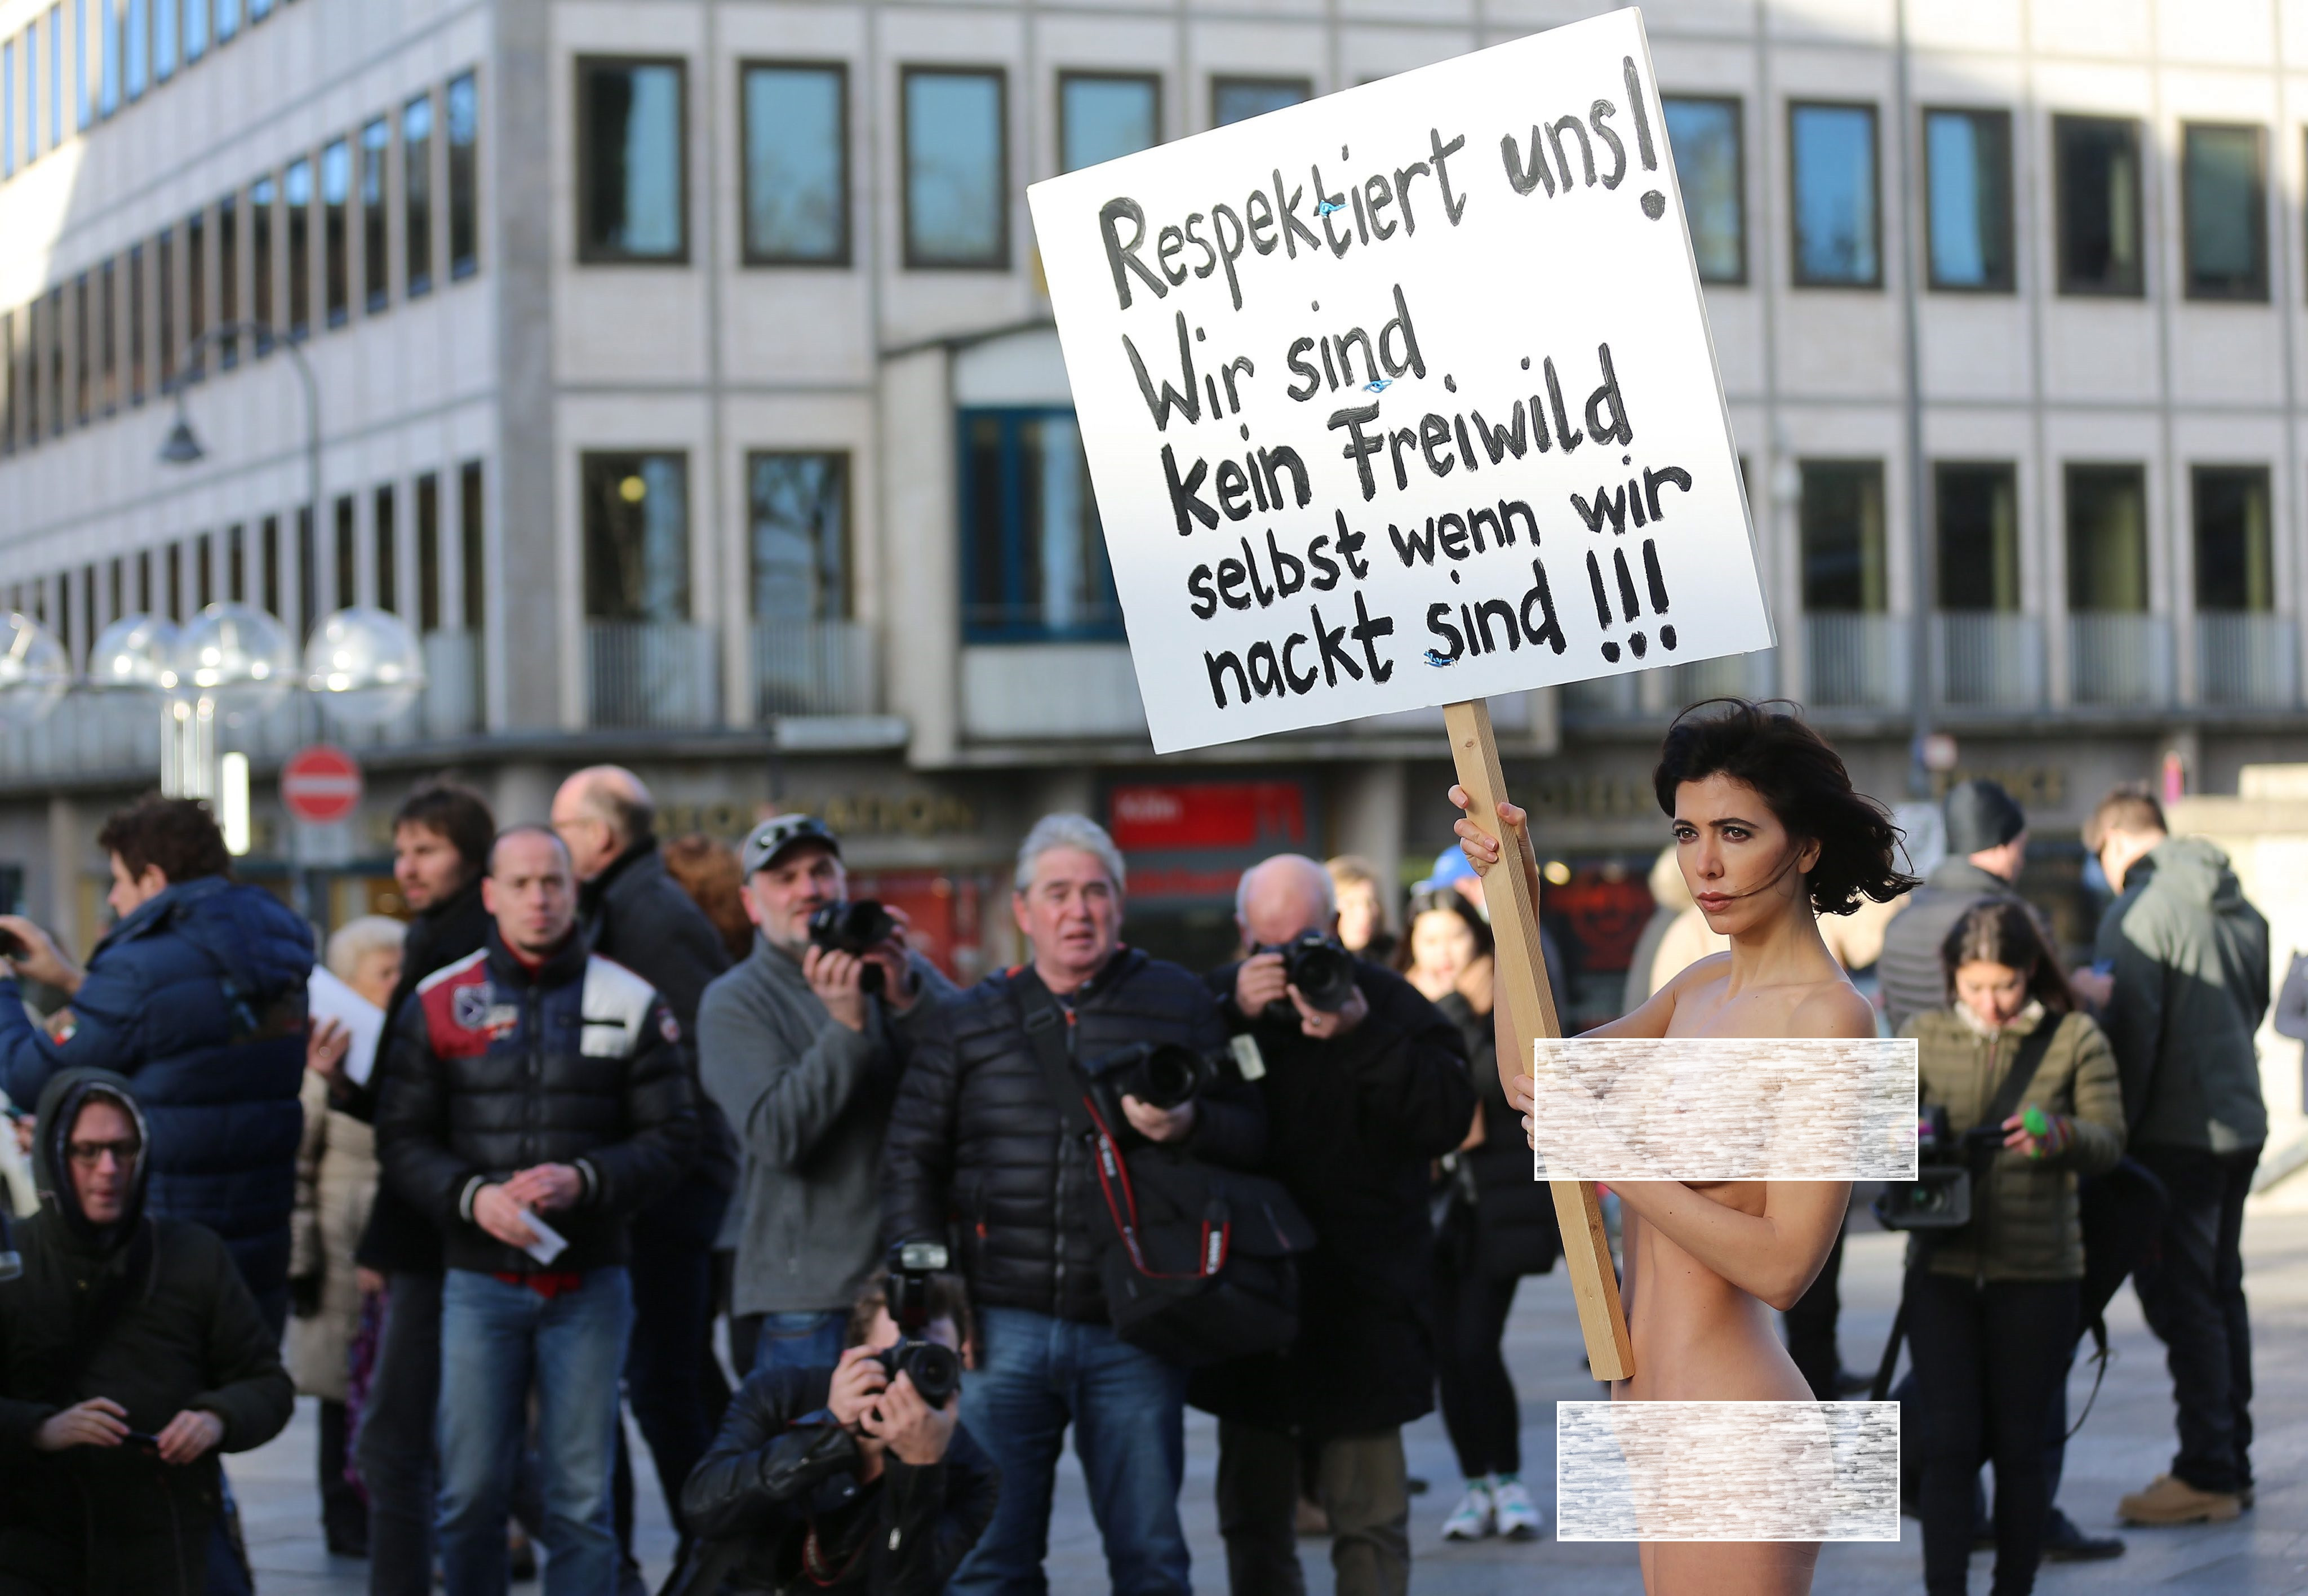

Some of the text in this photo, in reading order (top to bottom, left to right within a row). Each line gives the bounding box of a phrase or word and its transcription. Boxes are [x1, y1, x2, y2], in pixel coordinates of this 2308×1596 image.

[1098, 55, 1666, 313] Respektiert uns!
[1122, 283, 1427, 432] Wir sind
[1160, 341, 1634, 537] kein Freiwild
[1187, 454, 1693, 621] selbst wenn wir
[1202, 537, 1679, 710] nackt sind !!!
